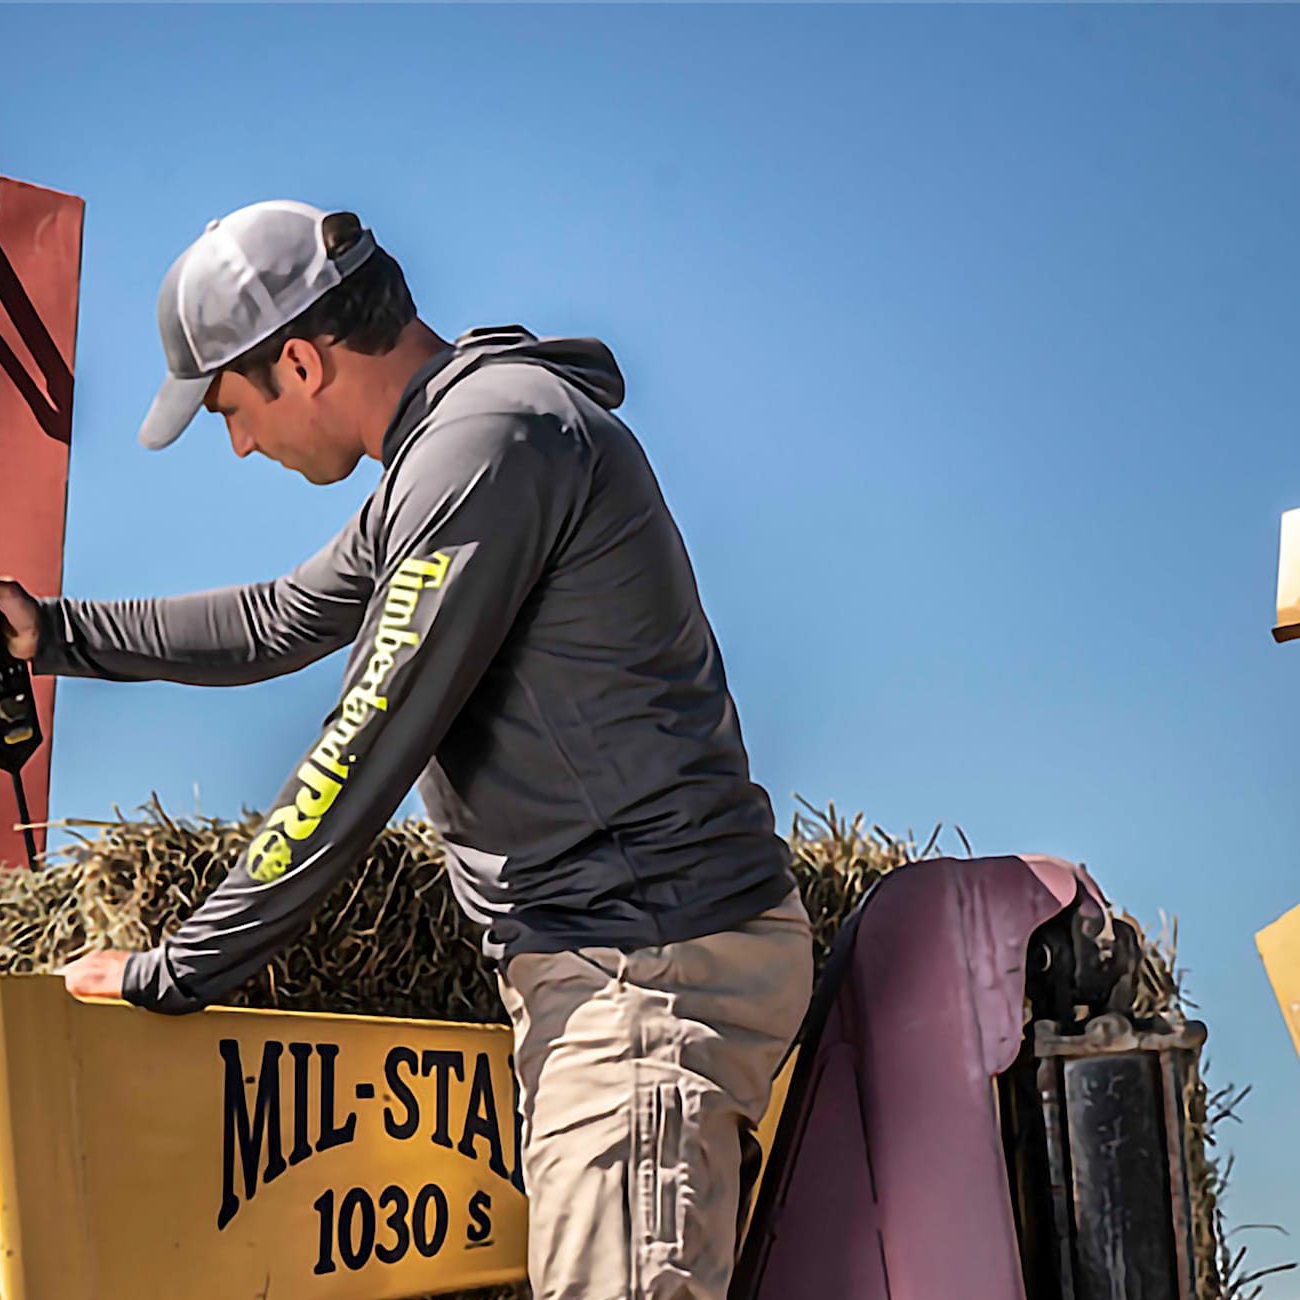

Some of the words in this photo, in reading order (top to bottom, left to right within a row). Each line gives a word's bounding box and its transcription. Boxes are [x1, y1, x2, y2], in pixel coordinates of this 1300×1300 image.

[308, 551, 450, 779] Timberland
[218, 1039, 525, 1231] MIL-STA
[314, 1183, 449, 1275] 1030
